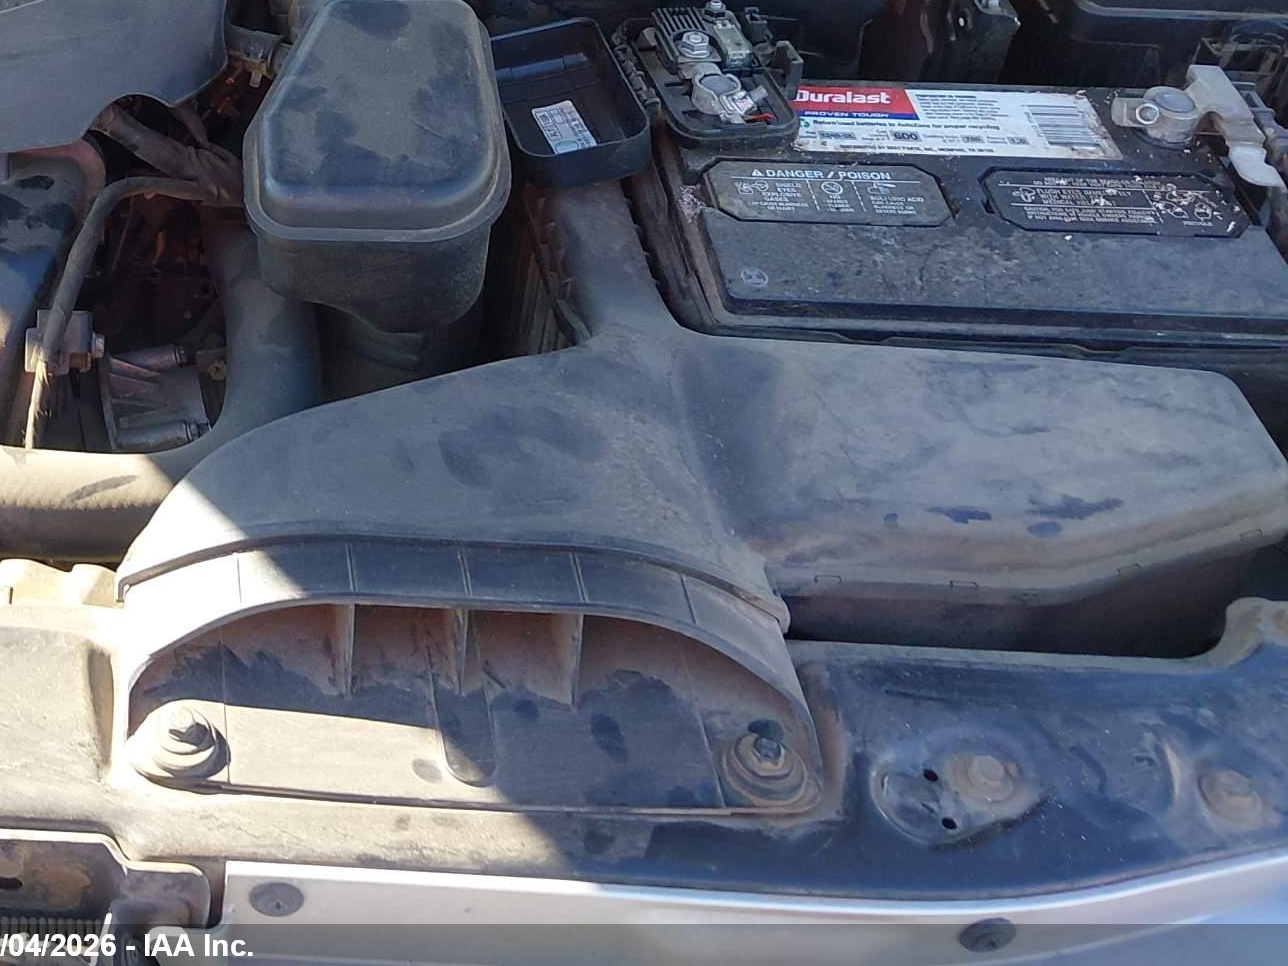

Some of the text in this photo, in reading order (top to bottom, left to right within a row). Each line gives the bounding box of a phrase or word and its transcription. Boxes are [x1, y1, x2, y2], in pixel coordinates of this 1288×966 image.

[793, 89, 891, 104] Duralast
[894, 131, 919, 140] 600
[765, 169, 824, 179] DANGER
[838, 171, 892, 180] POISON
